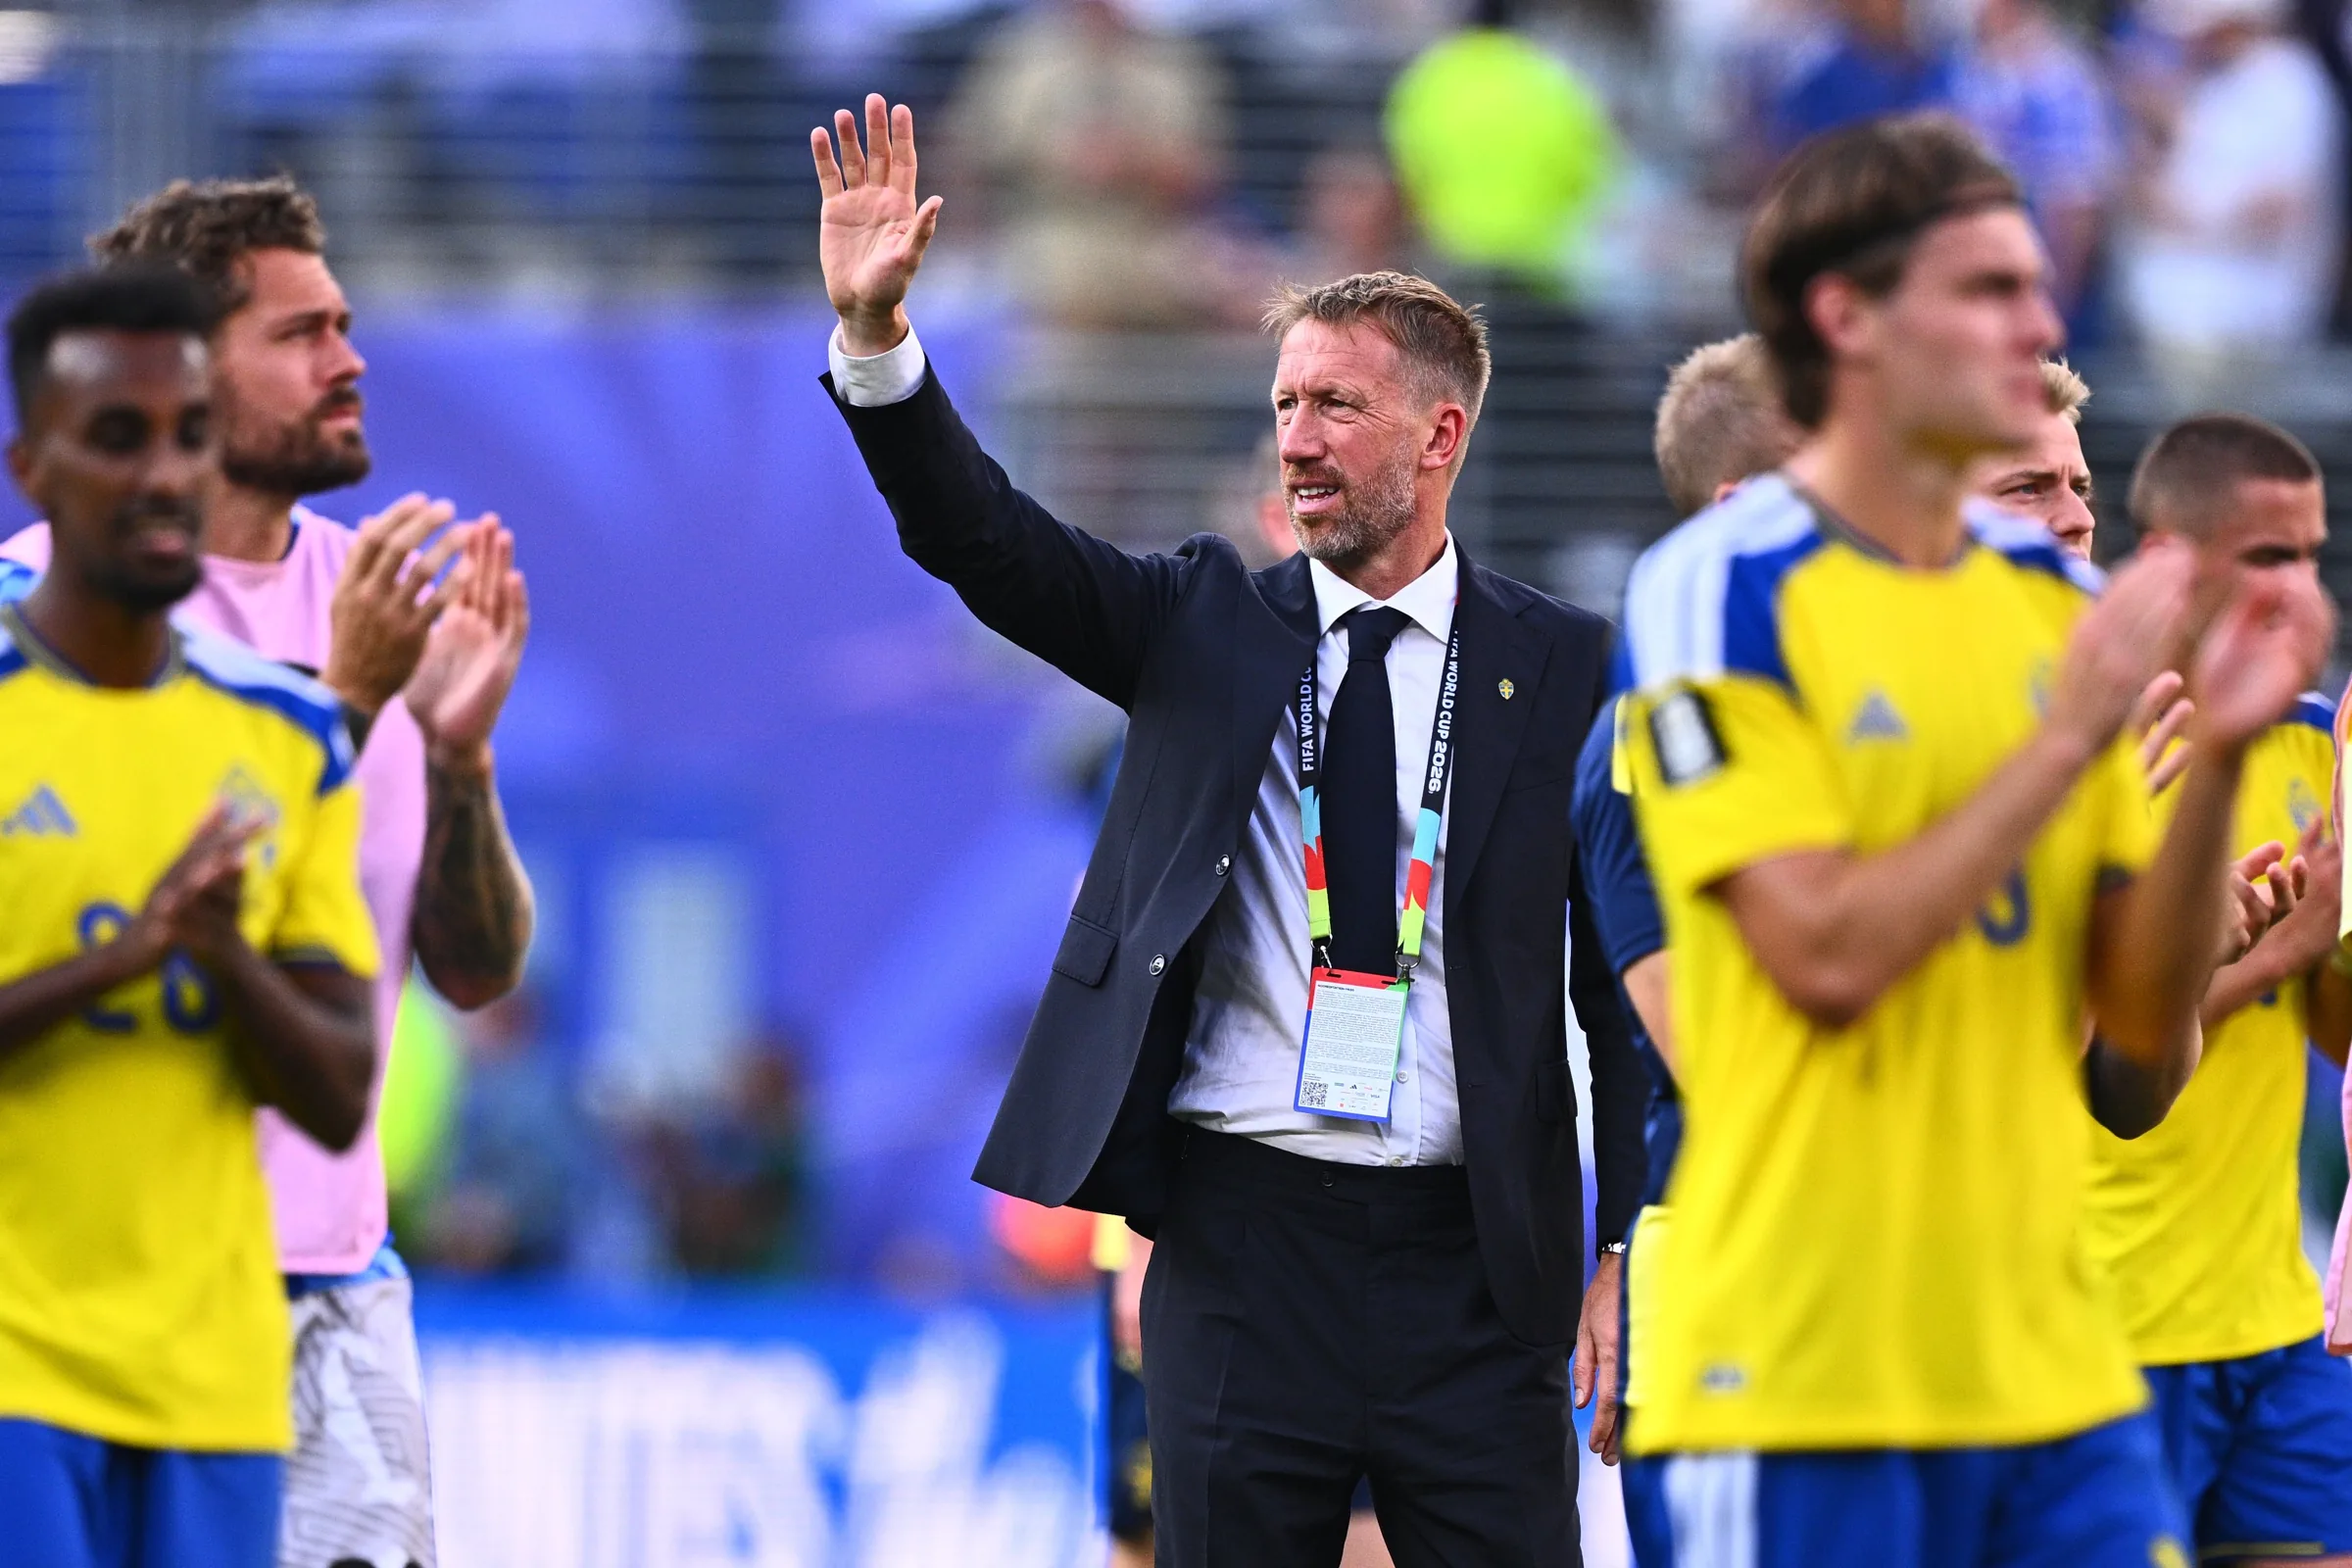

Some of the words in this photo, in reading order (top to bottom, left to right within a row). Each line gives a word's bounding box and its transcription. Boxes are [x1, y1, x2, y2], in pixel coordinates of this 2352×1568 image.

[1442, 661, 1458, 710] WORLD
[1299, 684, 1313, 738] WORLD
[1437, 711, 1452, 740] CUP
[1301, 740, 1314, 771] FIFA
